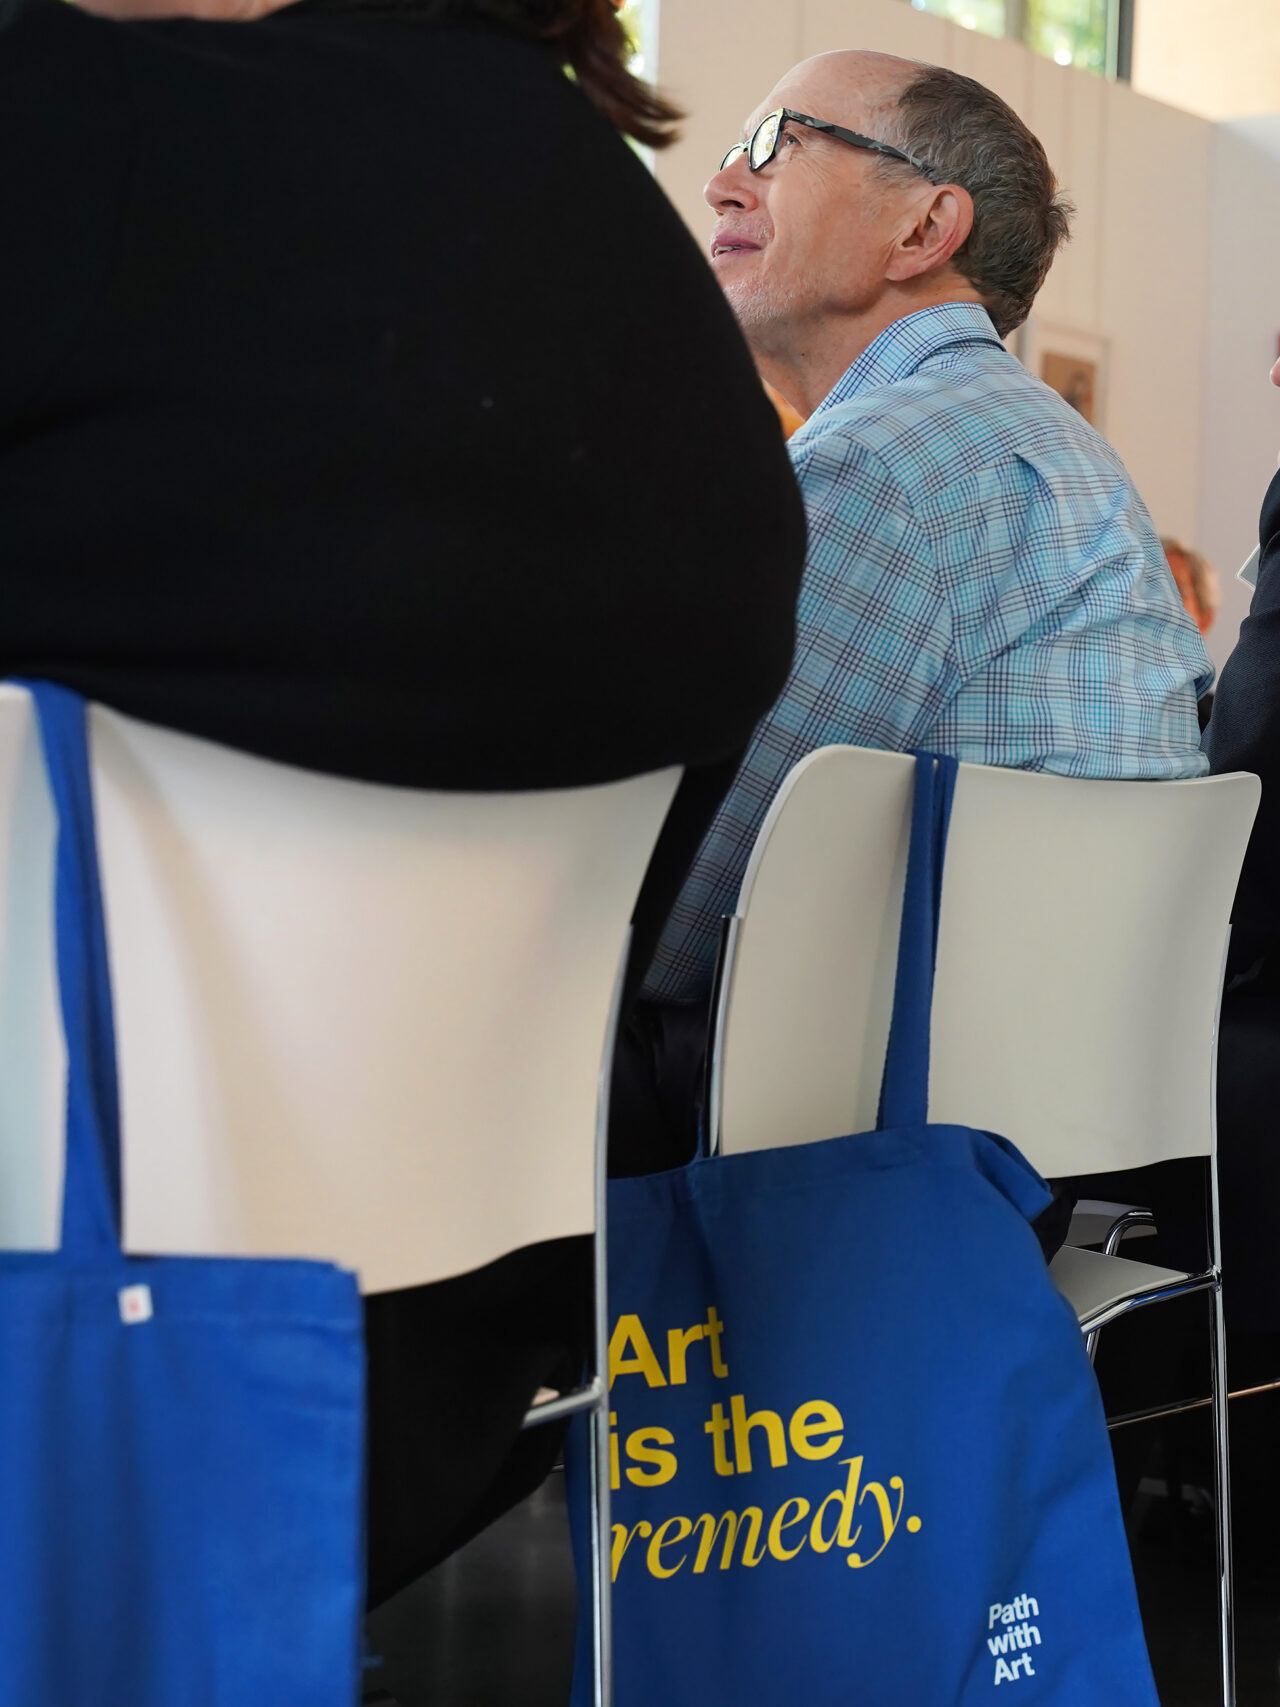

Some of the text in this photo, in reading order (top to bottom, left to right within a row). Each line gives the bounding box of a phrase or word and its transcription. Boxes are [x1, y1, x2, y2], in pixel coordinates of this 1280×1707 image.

[606, 1306, 728, 1393] Art
[606, 1395, 845, 1490] is the
[607, 1455, 922, 1583] remedy.
[987, 1621, 1042, 1656] with
[988, 1593, 1040, 1629] Path
[993, 1652, 1036, 1686] Art
